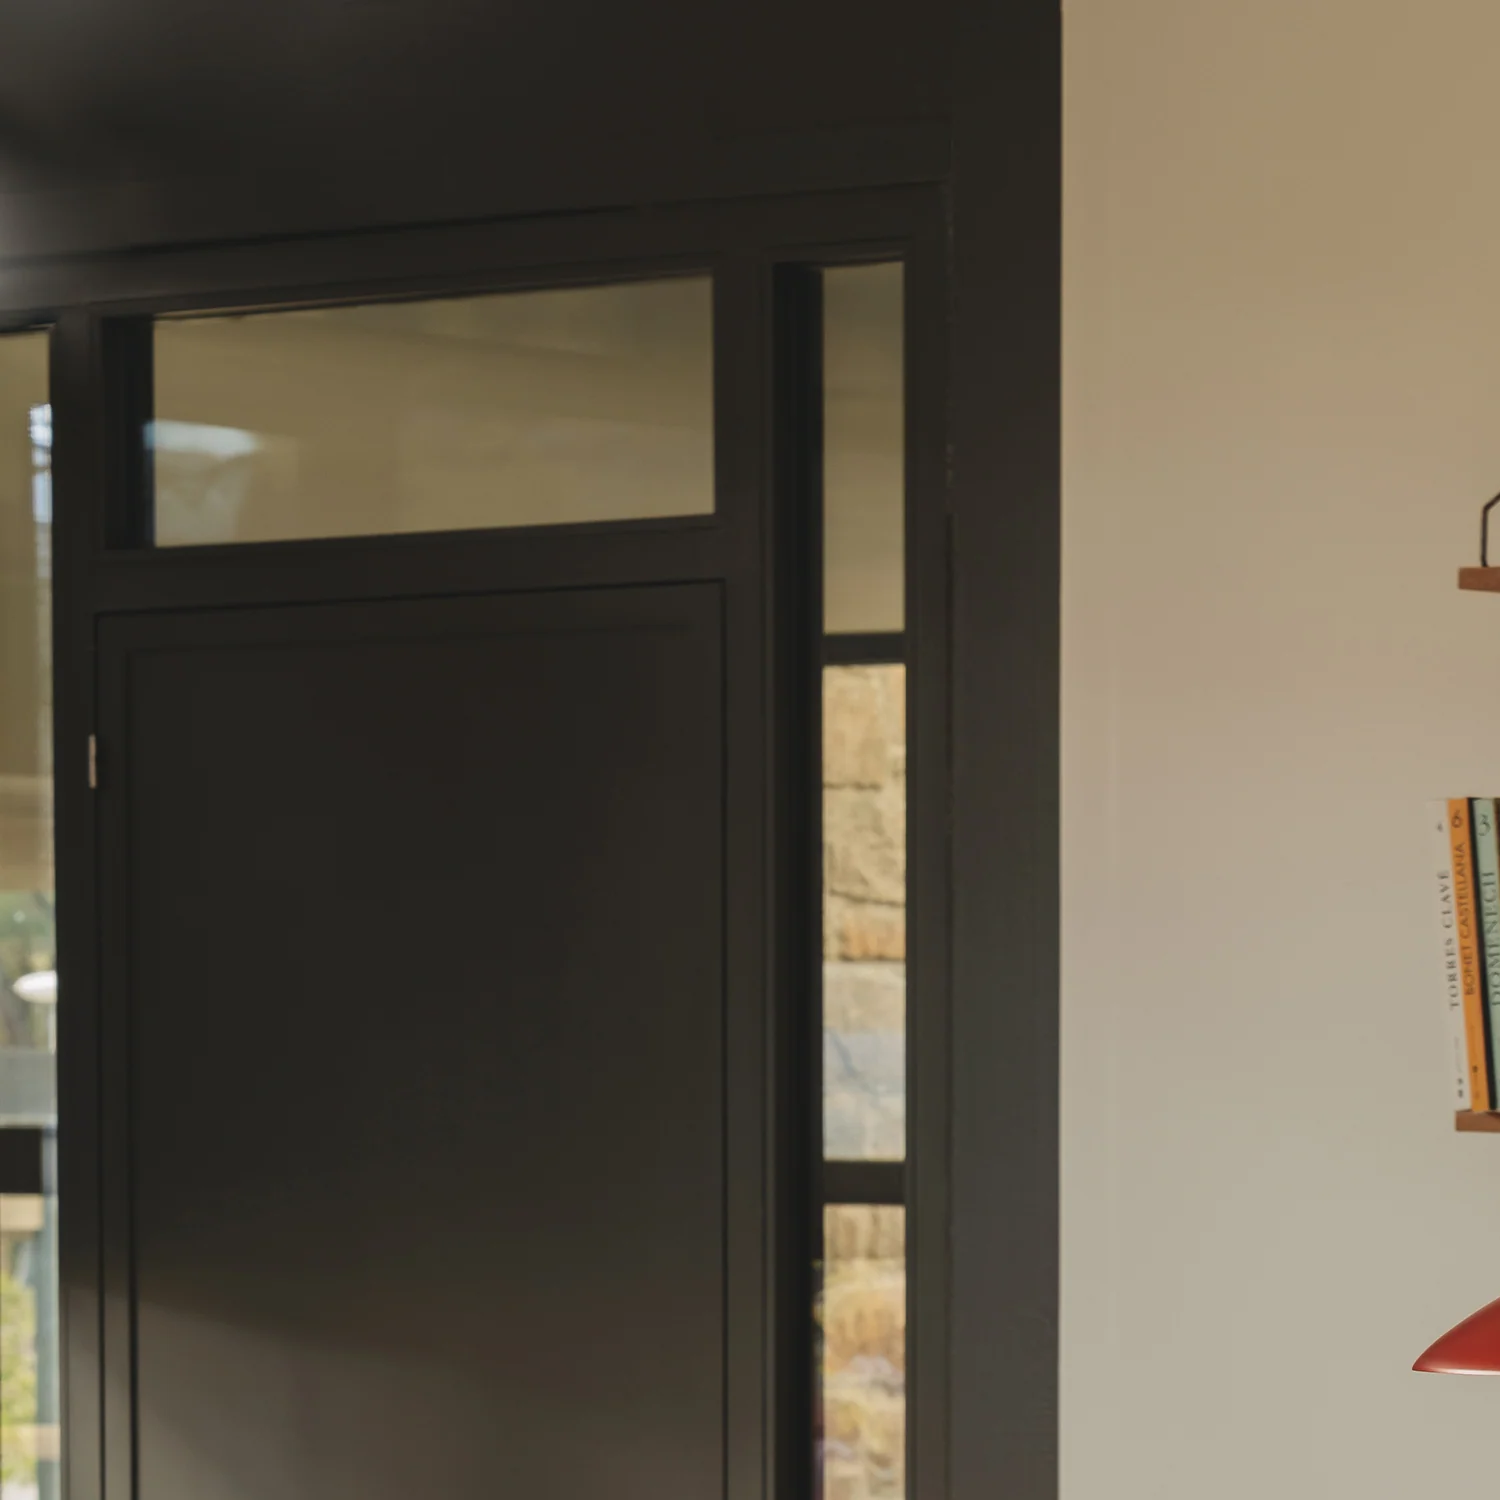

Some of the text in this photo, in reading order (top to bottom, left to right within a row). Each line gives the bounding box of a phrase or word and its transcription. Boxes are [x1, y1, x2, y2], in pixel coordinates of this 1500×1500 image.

[1444, 937, 1461, 1009] TORRES
[1453, 842, 1476, 995] BONET CASTELLANA
